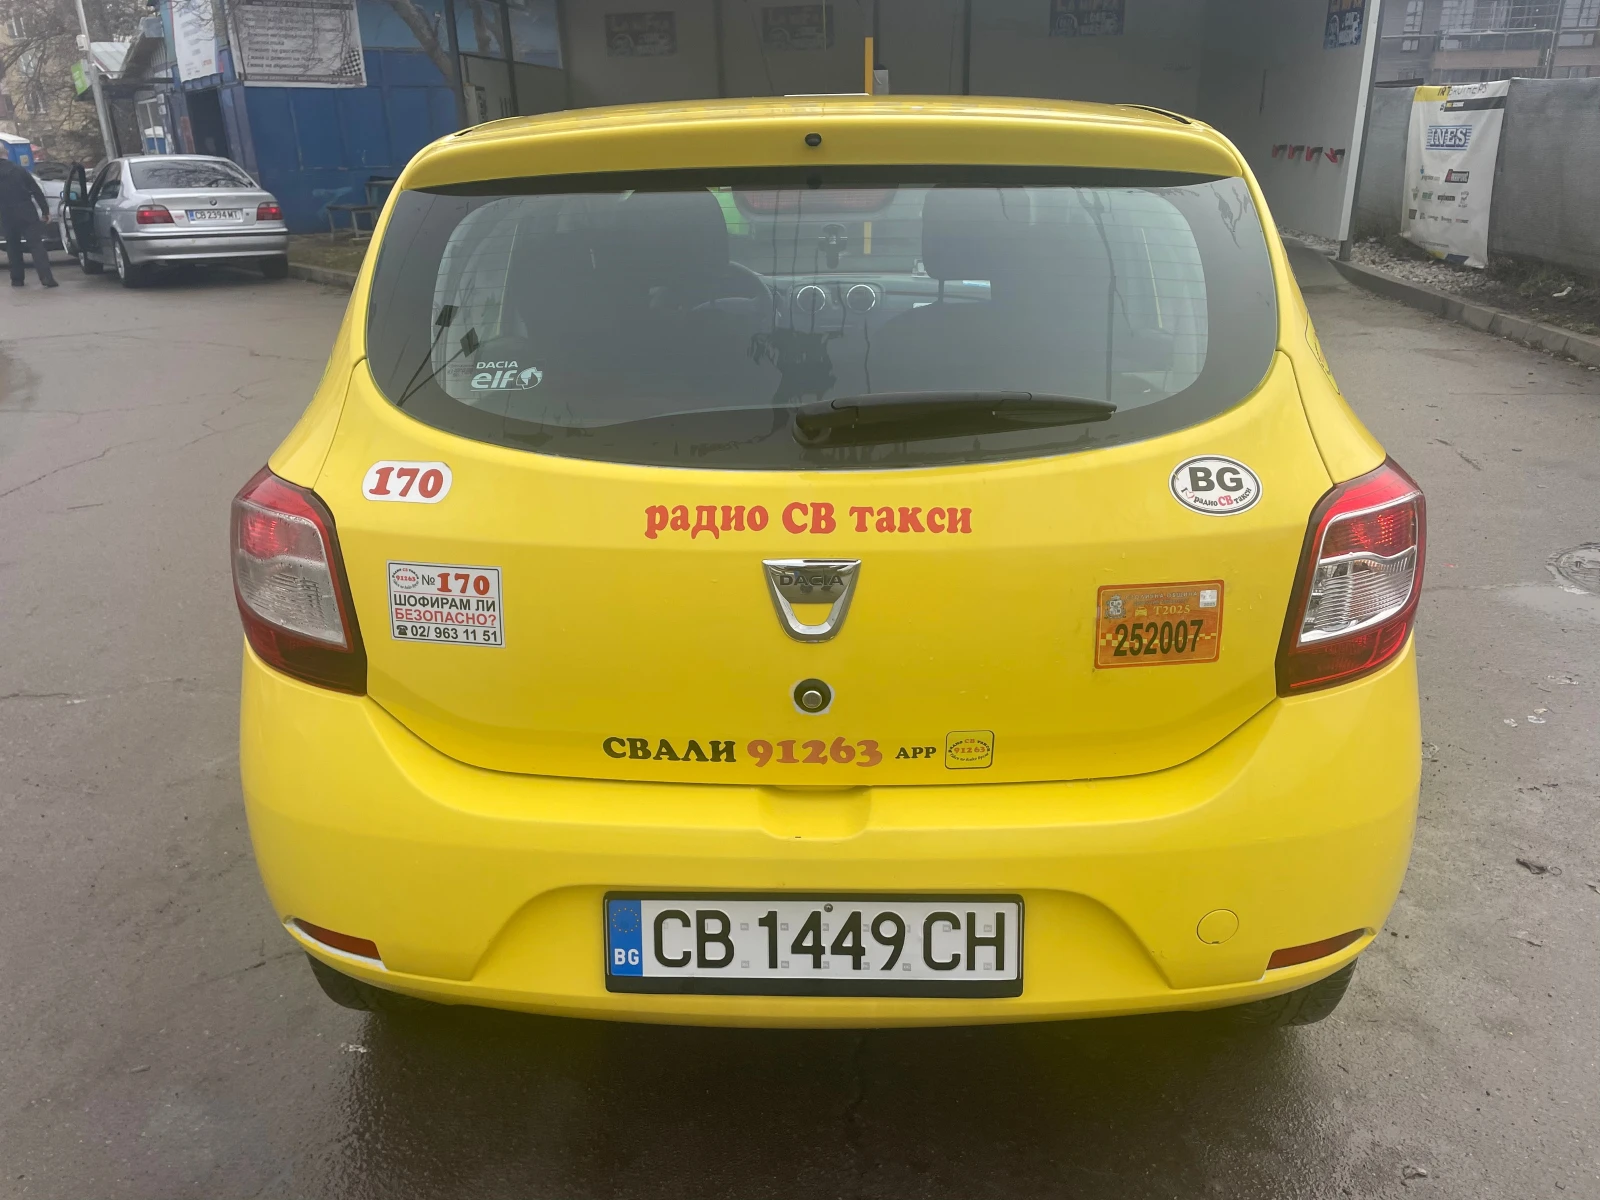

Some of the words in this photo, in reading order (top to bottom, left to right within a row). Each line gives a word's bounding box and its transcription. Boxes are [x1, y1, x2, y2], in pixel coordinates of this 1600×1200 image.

[1430, 128, 1467, 147] INES
[476, 360, 518, 369] DACIA
[471, 369, 517, 389] elf
[368, 466, 444, 498] 170
[1188, 466, 1244, 492] BG
[644, 504, 769, 540] радио
[781, 501, 837, 535] СВ
[848, 505, 973, 534] такси
[395, 574, 416, 582] 91263
[436, 572, 490, 596] 170
[780, 575, 844, 586] DACIA
[393, 593, 471, 611] ШОФИРАМ
[475, 599, 496, 612] ЛИ
[1153, 604, 1191, 615] T2025
[394, 607, 497, 626] БЕЗОПАСНО?
[410, 625, 431, 638] 02/
[434, 626, 459, 640] 963
[463, 628, 477, 641] 11
[482, 629, 498, 643] 51
[1113, 619, 1204, 657] 252007
[602, 736, 736, 763] СВАЛИ
[746, 737, 883, 768] 91263
[895, 745, 938, 760] APP
[653, 909, 735, 969] CB
[757, 910, 906, 972] 1449
[921, 911, 1006, 972] CH
[613, 947, 640, 966] BG
